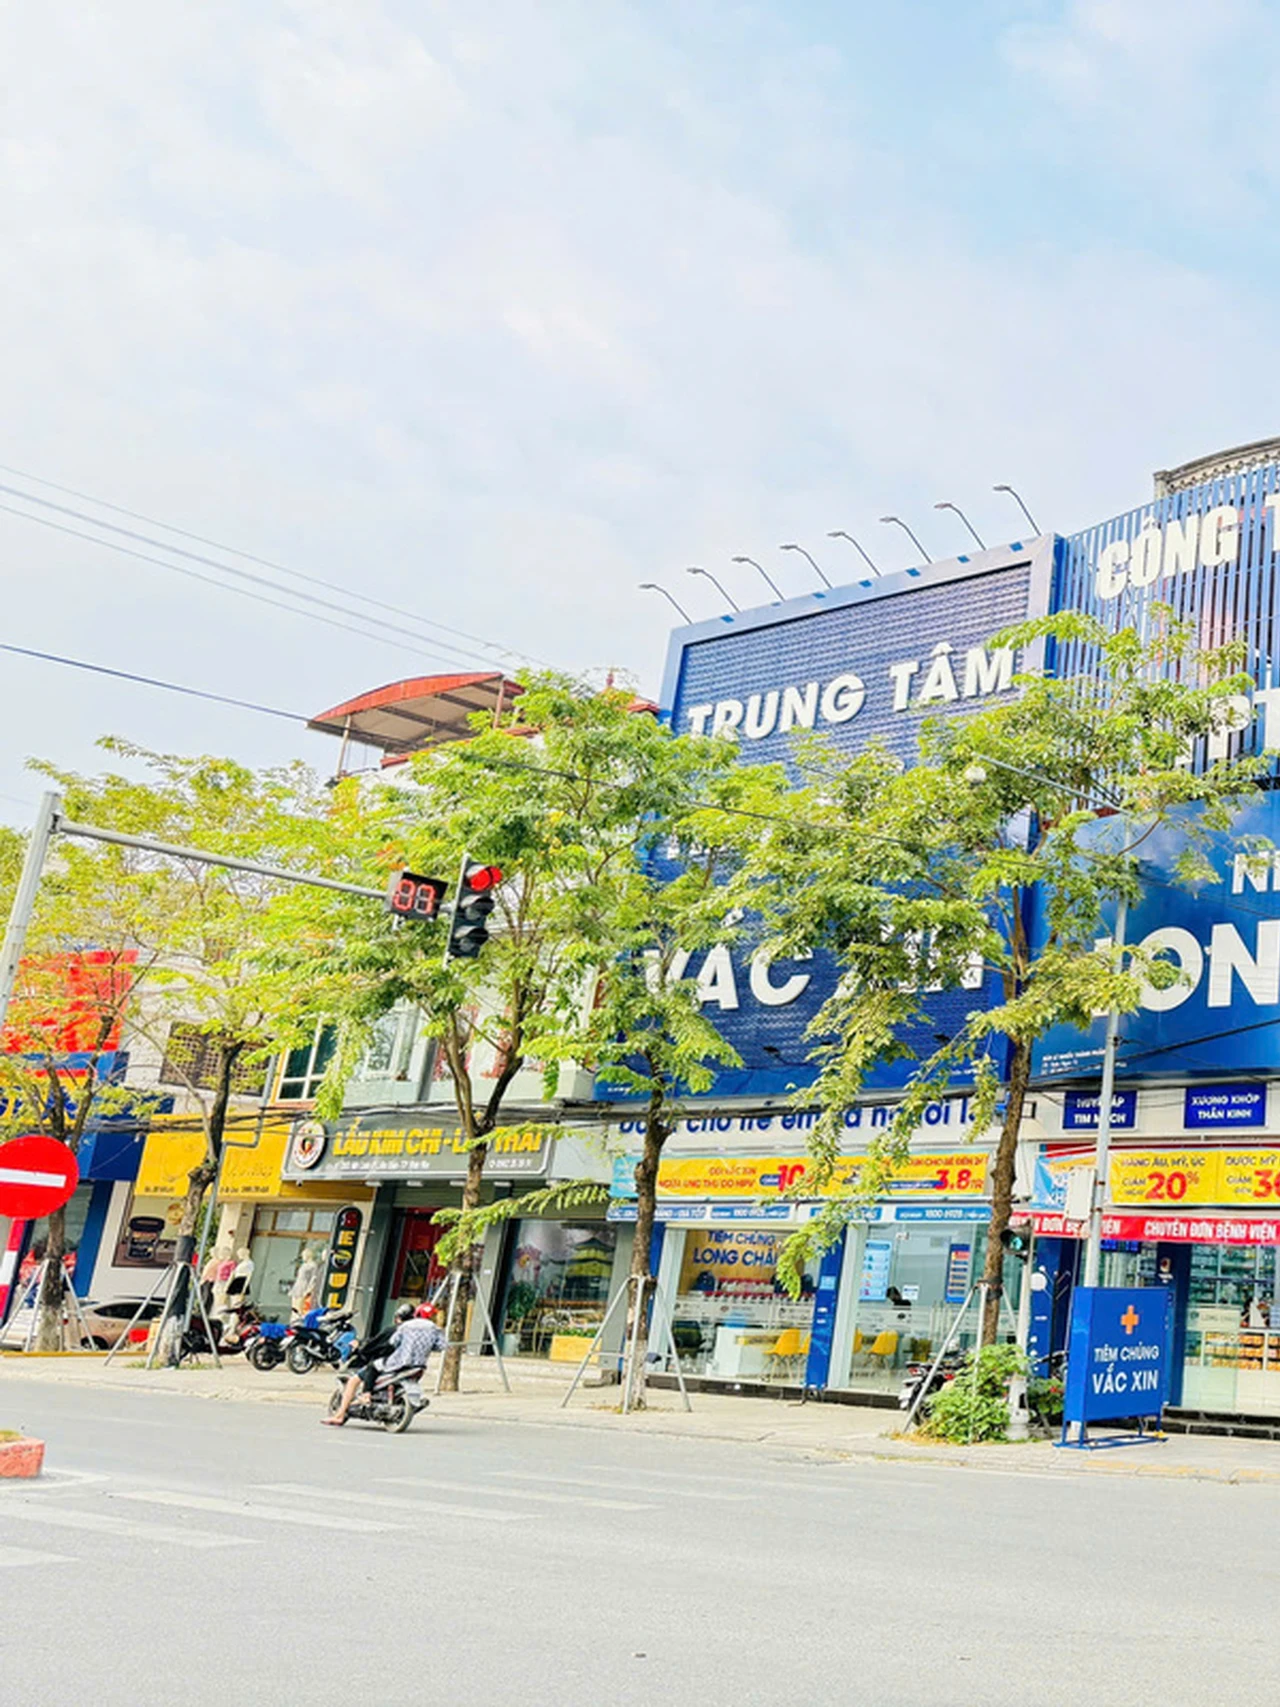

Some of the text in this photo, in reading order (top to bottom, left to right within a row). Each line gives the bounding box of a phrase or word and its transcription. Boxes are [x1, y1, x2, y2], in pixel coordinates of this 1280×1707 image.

[1096, 504, 1238, 600] CÔNG
[688, 641, 1017, 740] TRUNG TÂM
[693, 1248, 738, 1265] LONG
[1094, 1340, 1159, 1362] TIÊM CHỦNG
[1092, 1362, 1159, 1394] VẮC XIN
